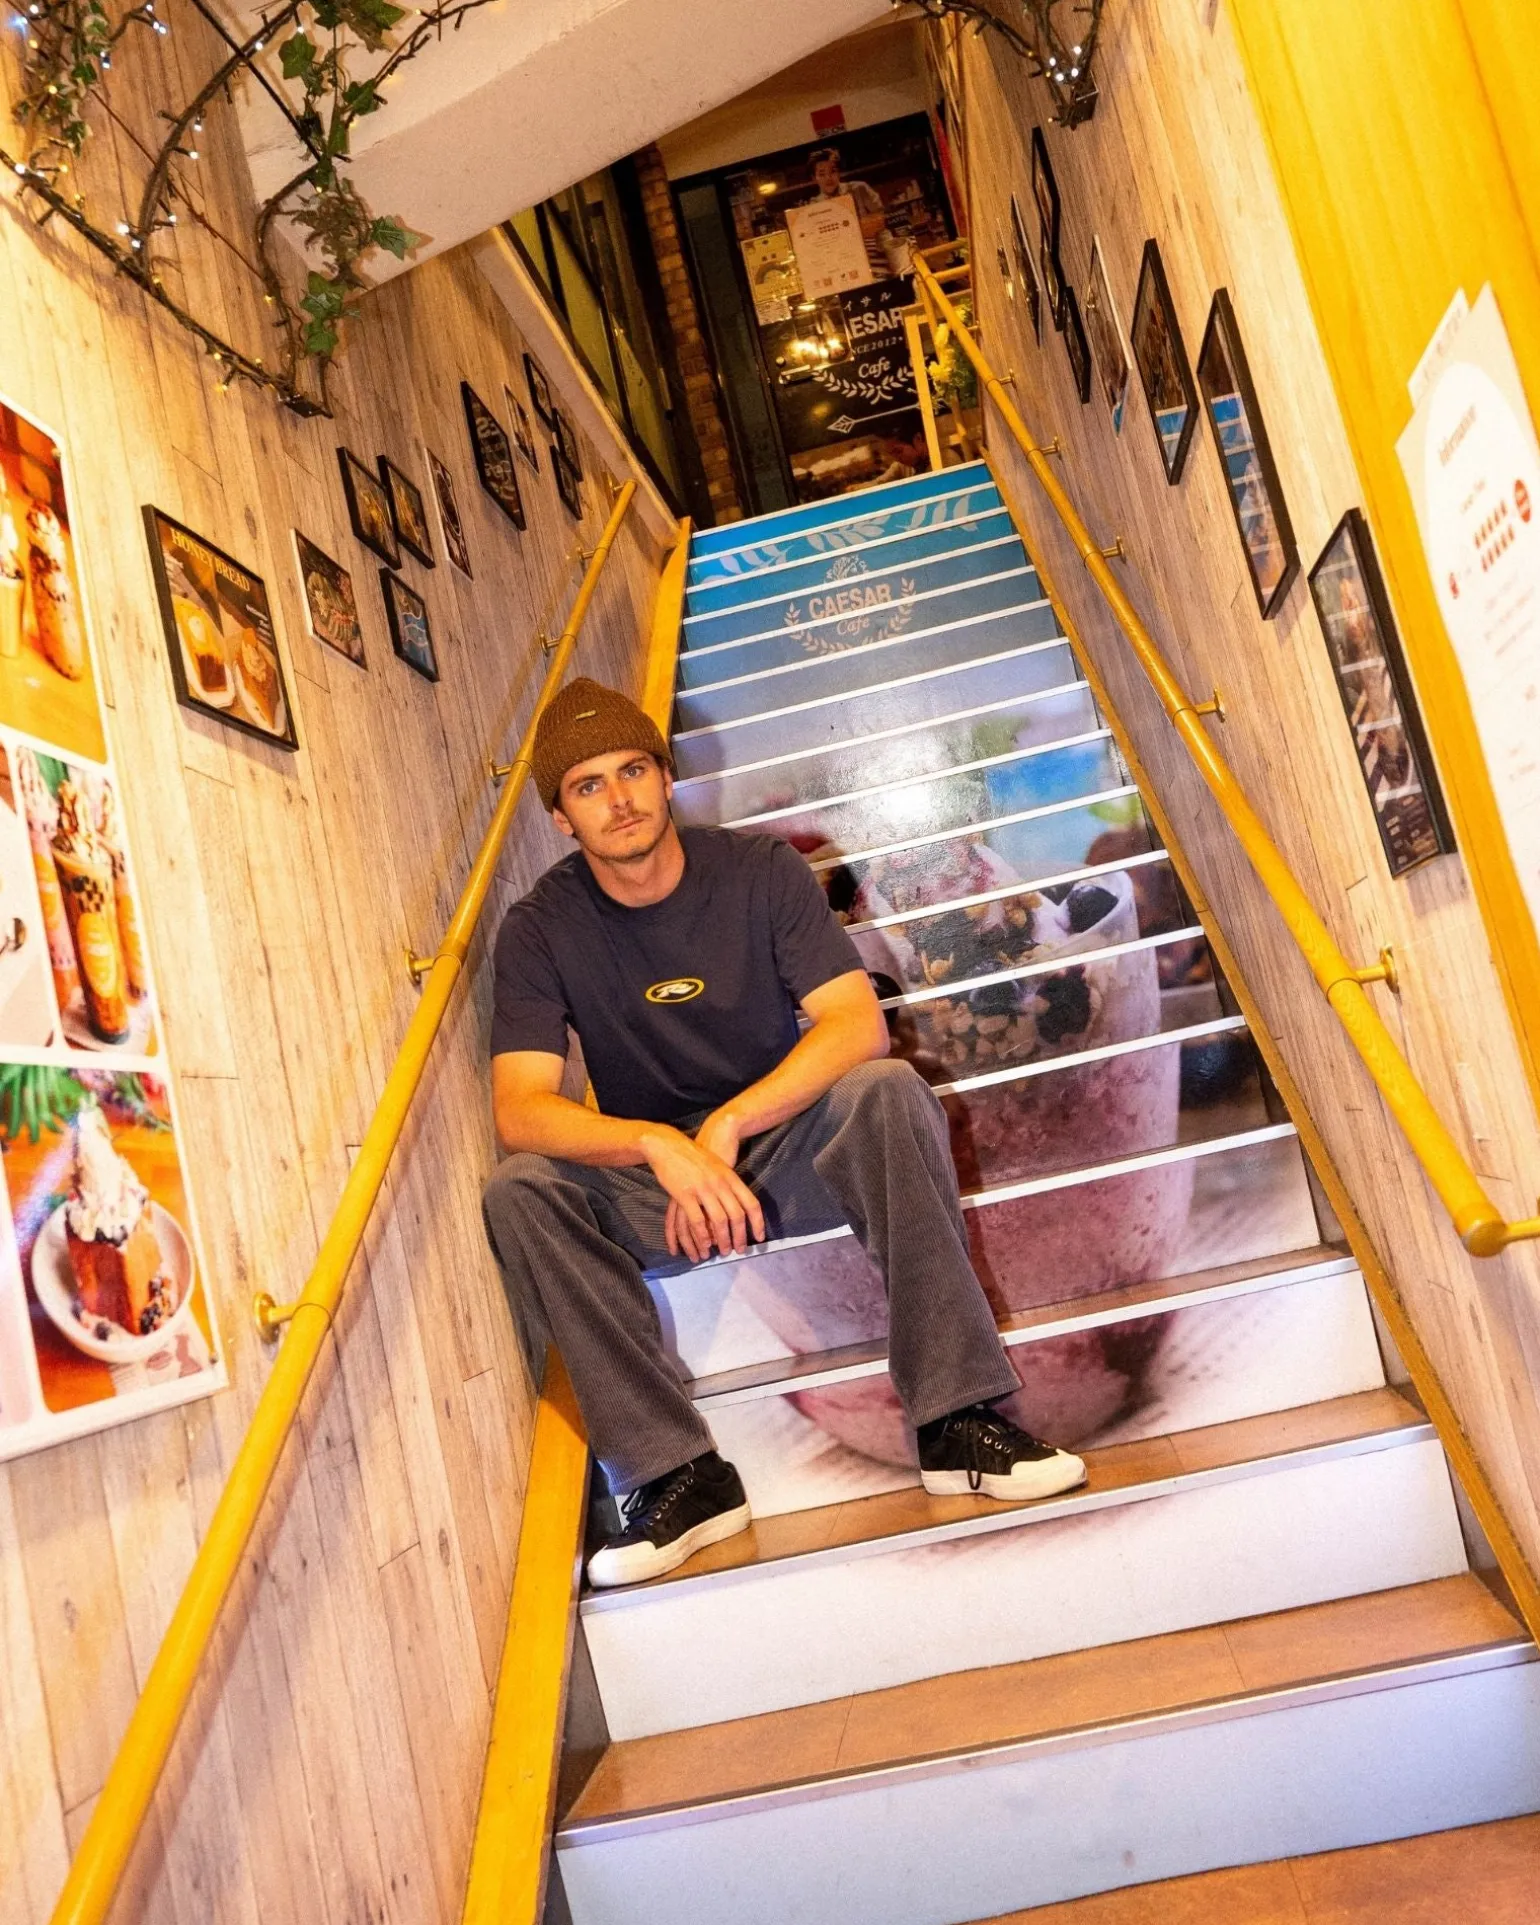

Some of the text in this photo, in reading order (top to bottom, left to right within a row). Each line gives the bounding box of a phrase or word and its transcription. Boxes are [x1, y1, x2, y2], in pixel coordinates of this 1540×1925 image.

[842, 307, 904, 340] ESAR
[170, 527, 250, 592] HONEY BREAD
[808, 583, 892, 620] CAESAR
